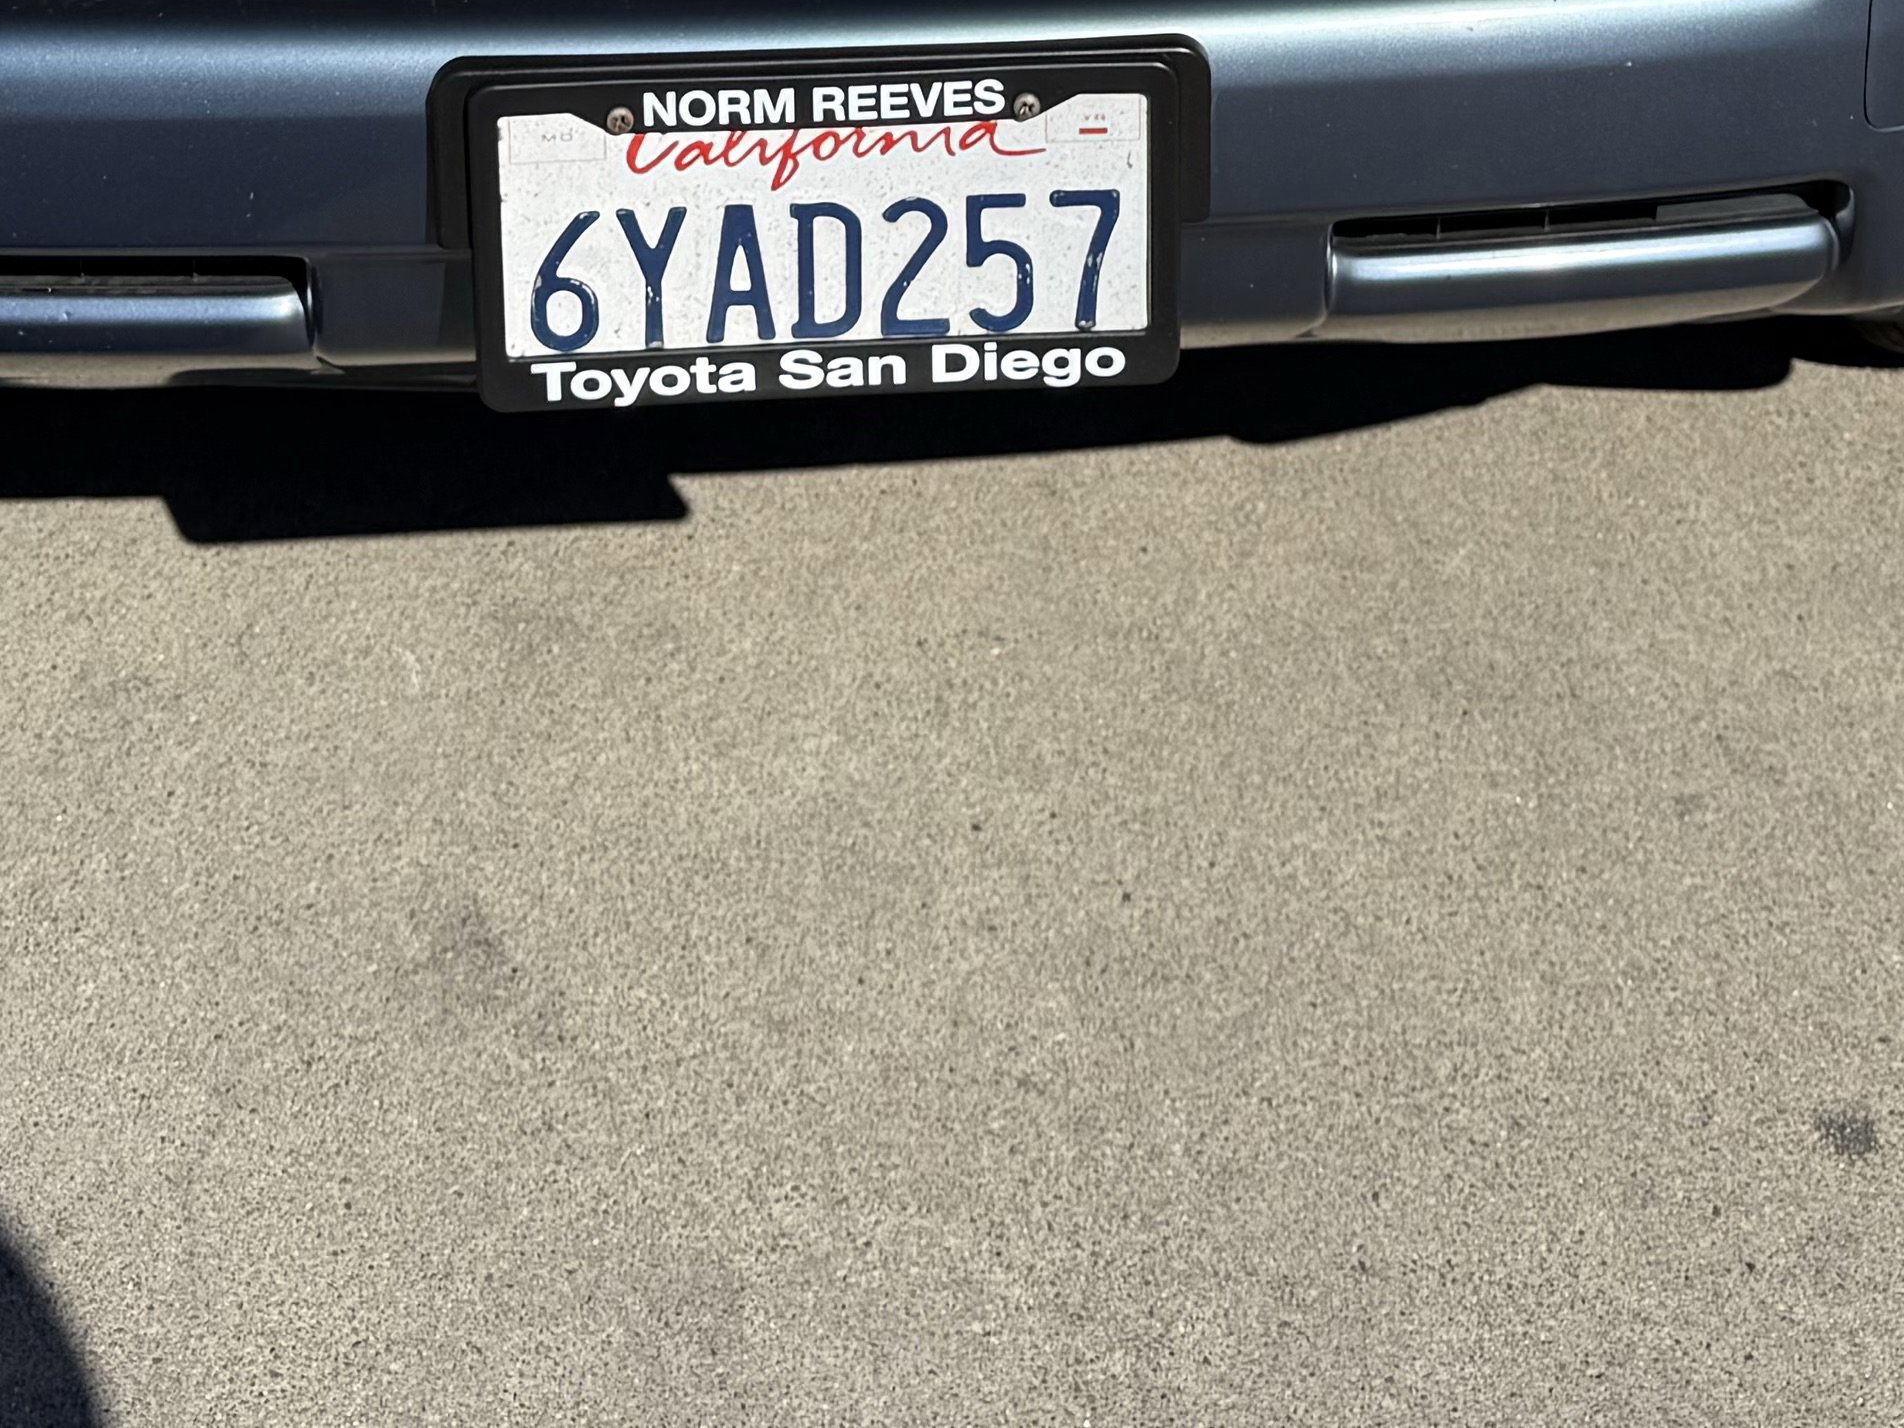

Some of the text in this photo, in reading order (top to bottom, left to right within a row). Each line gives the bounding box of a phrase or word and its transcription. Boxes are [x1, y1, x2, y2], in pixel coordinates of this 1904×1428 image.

[642, 78, 1006, 129] NORM REEVES
[625, 120, 1046, 191] California
[530, 188, 1121, 352] 6YAD257
[531, 341, 1127, 408] Toyota San Diego
